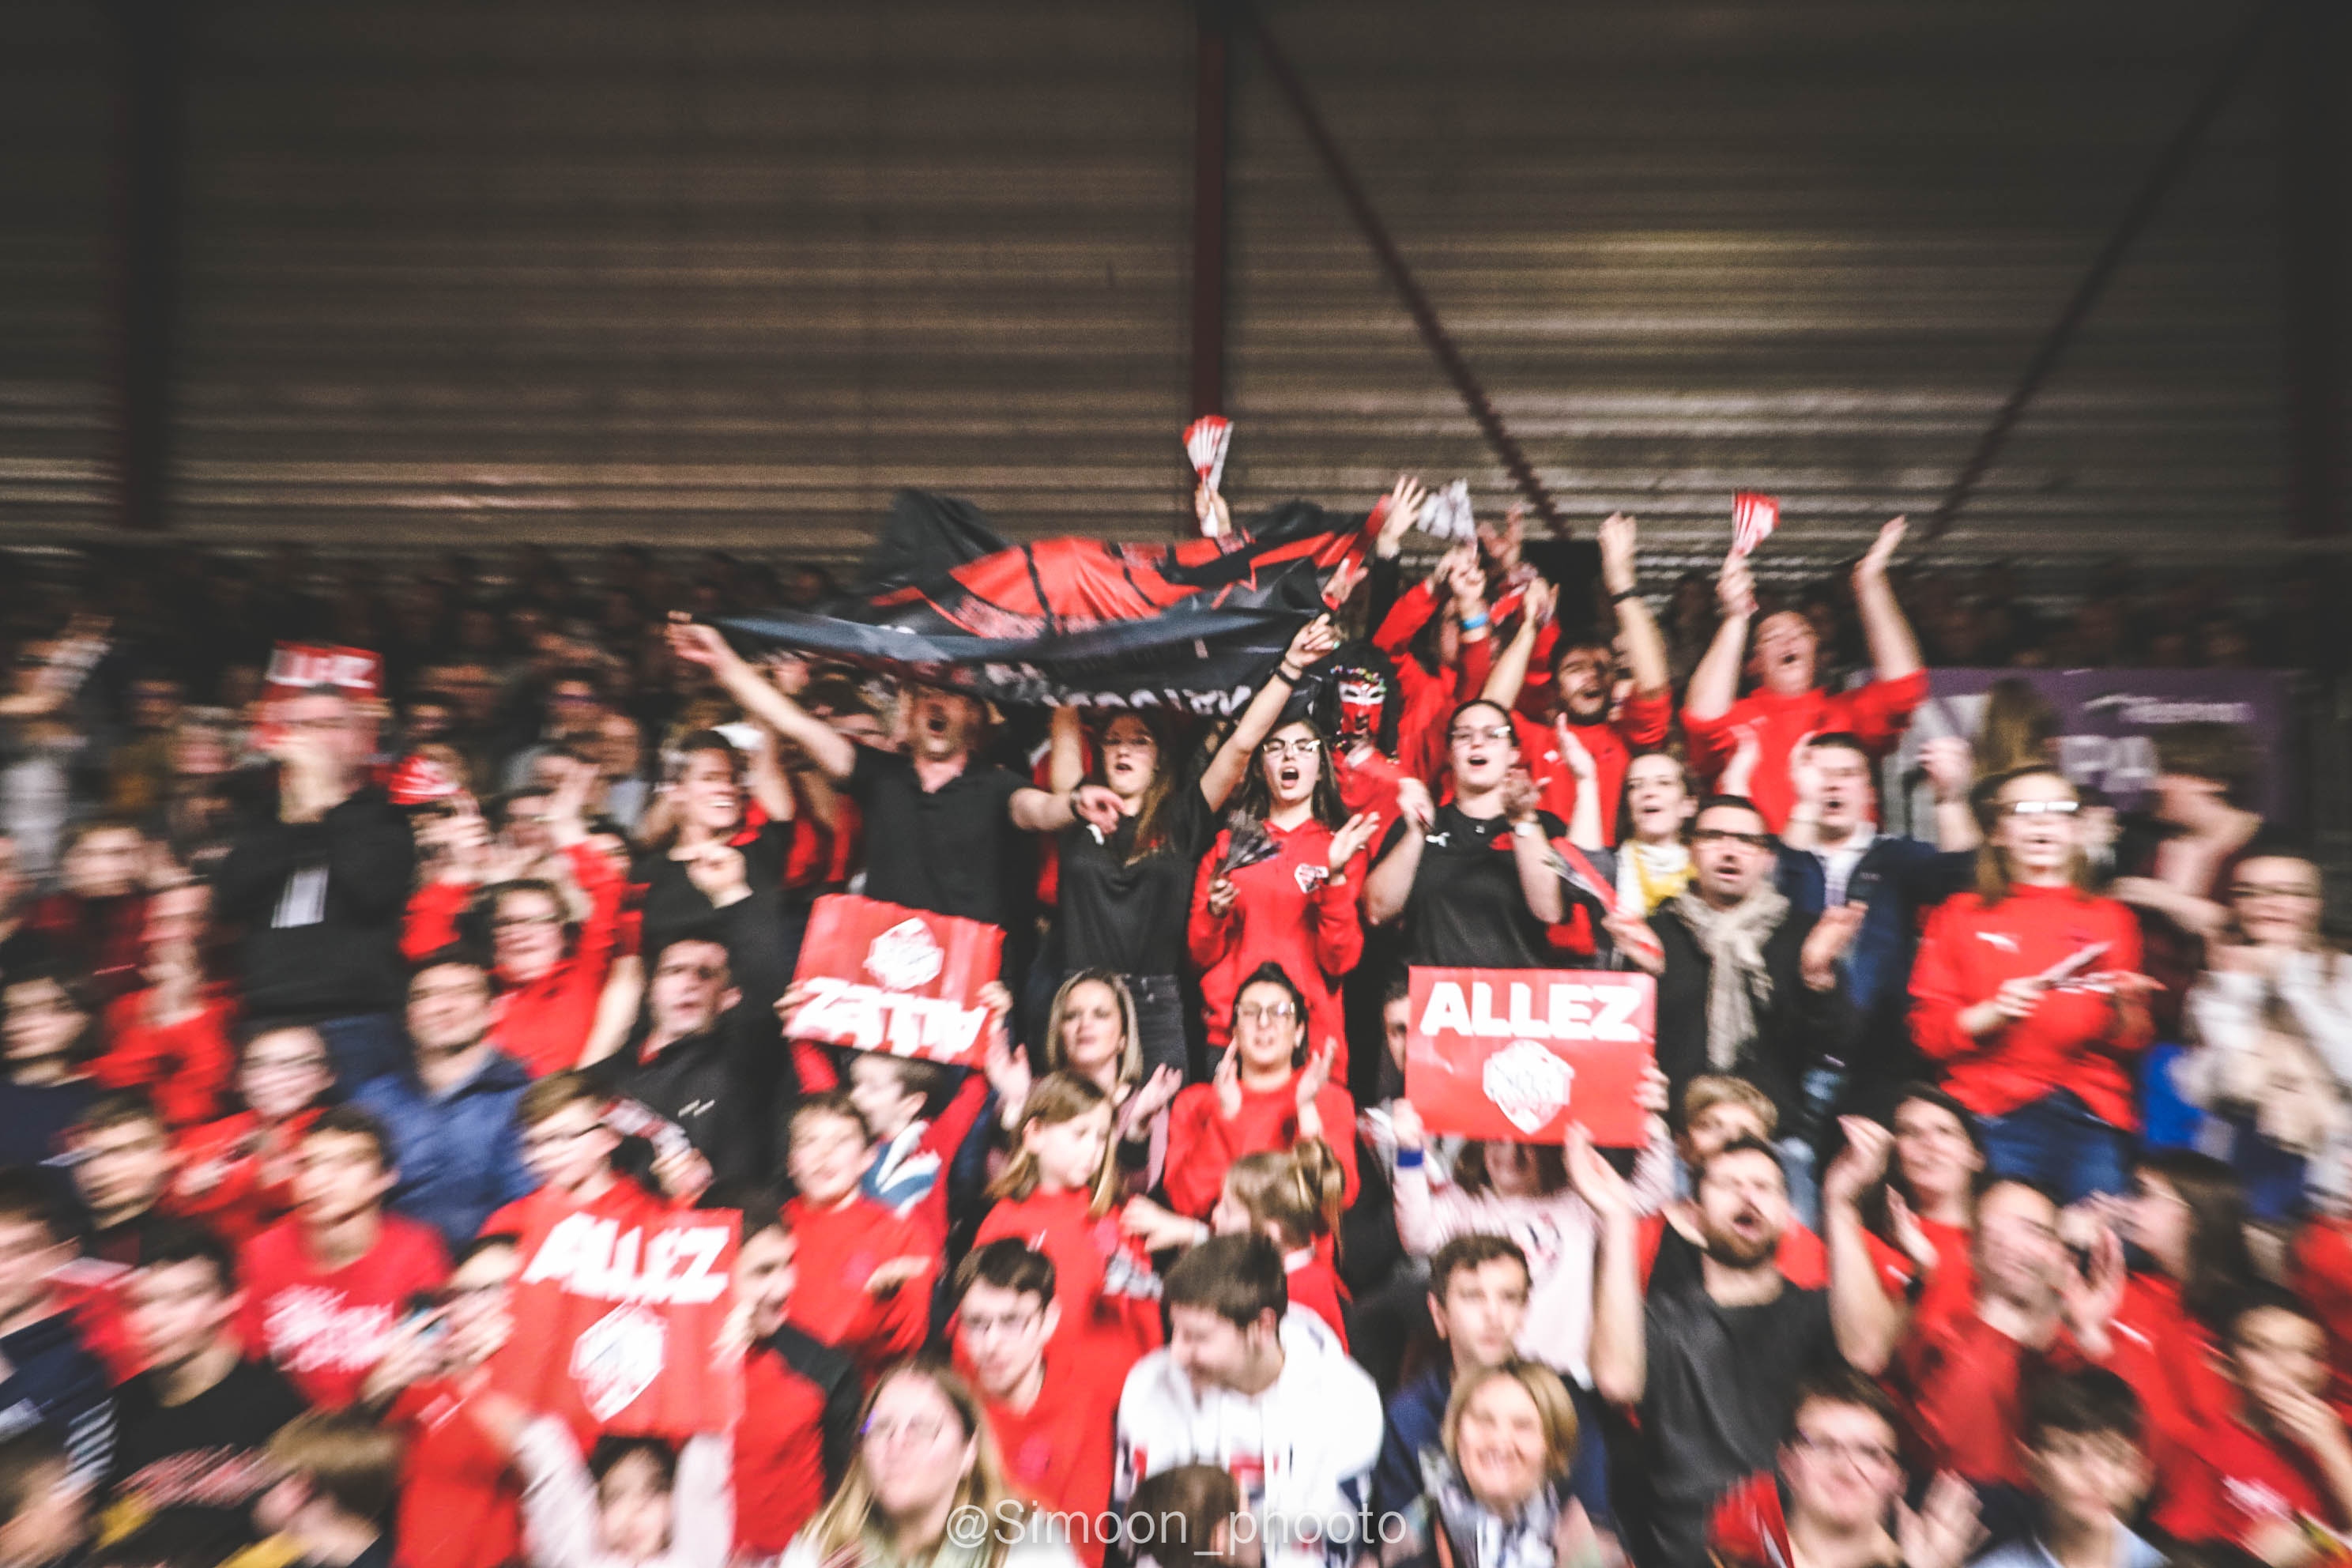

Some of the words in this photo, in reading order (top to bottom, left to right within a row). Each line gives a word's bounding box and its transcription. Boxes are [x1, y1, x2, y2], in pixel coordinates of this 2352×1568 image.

[782, 976, 988, 1061] ALLEZ
[1419, 982, 1642, 1042] ALLEZ
[521, 1211, 729, 1304] ALLEZ
